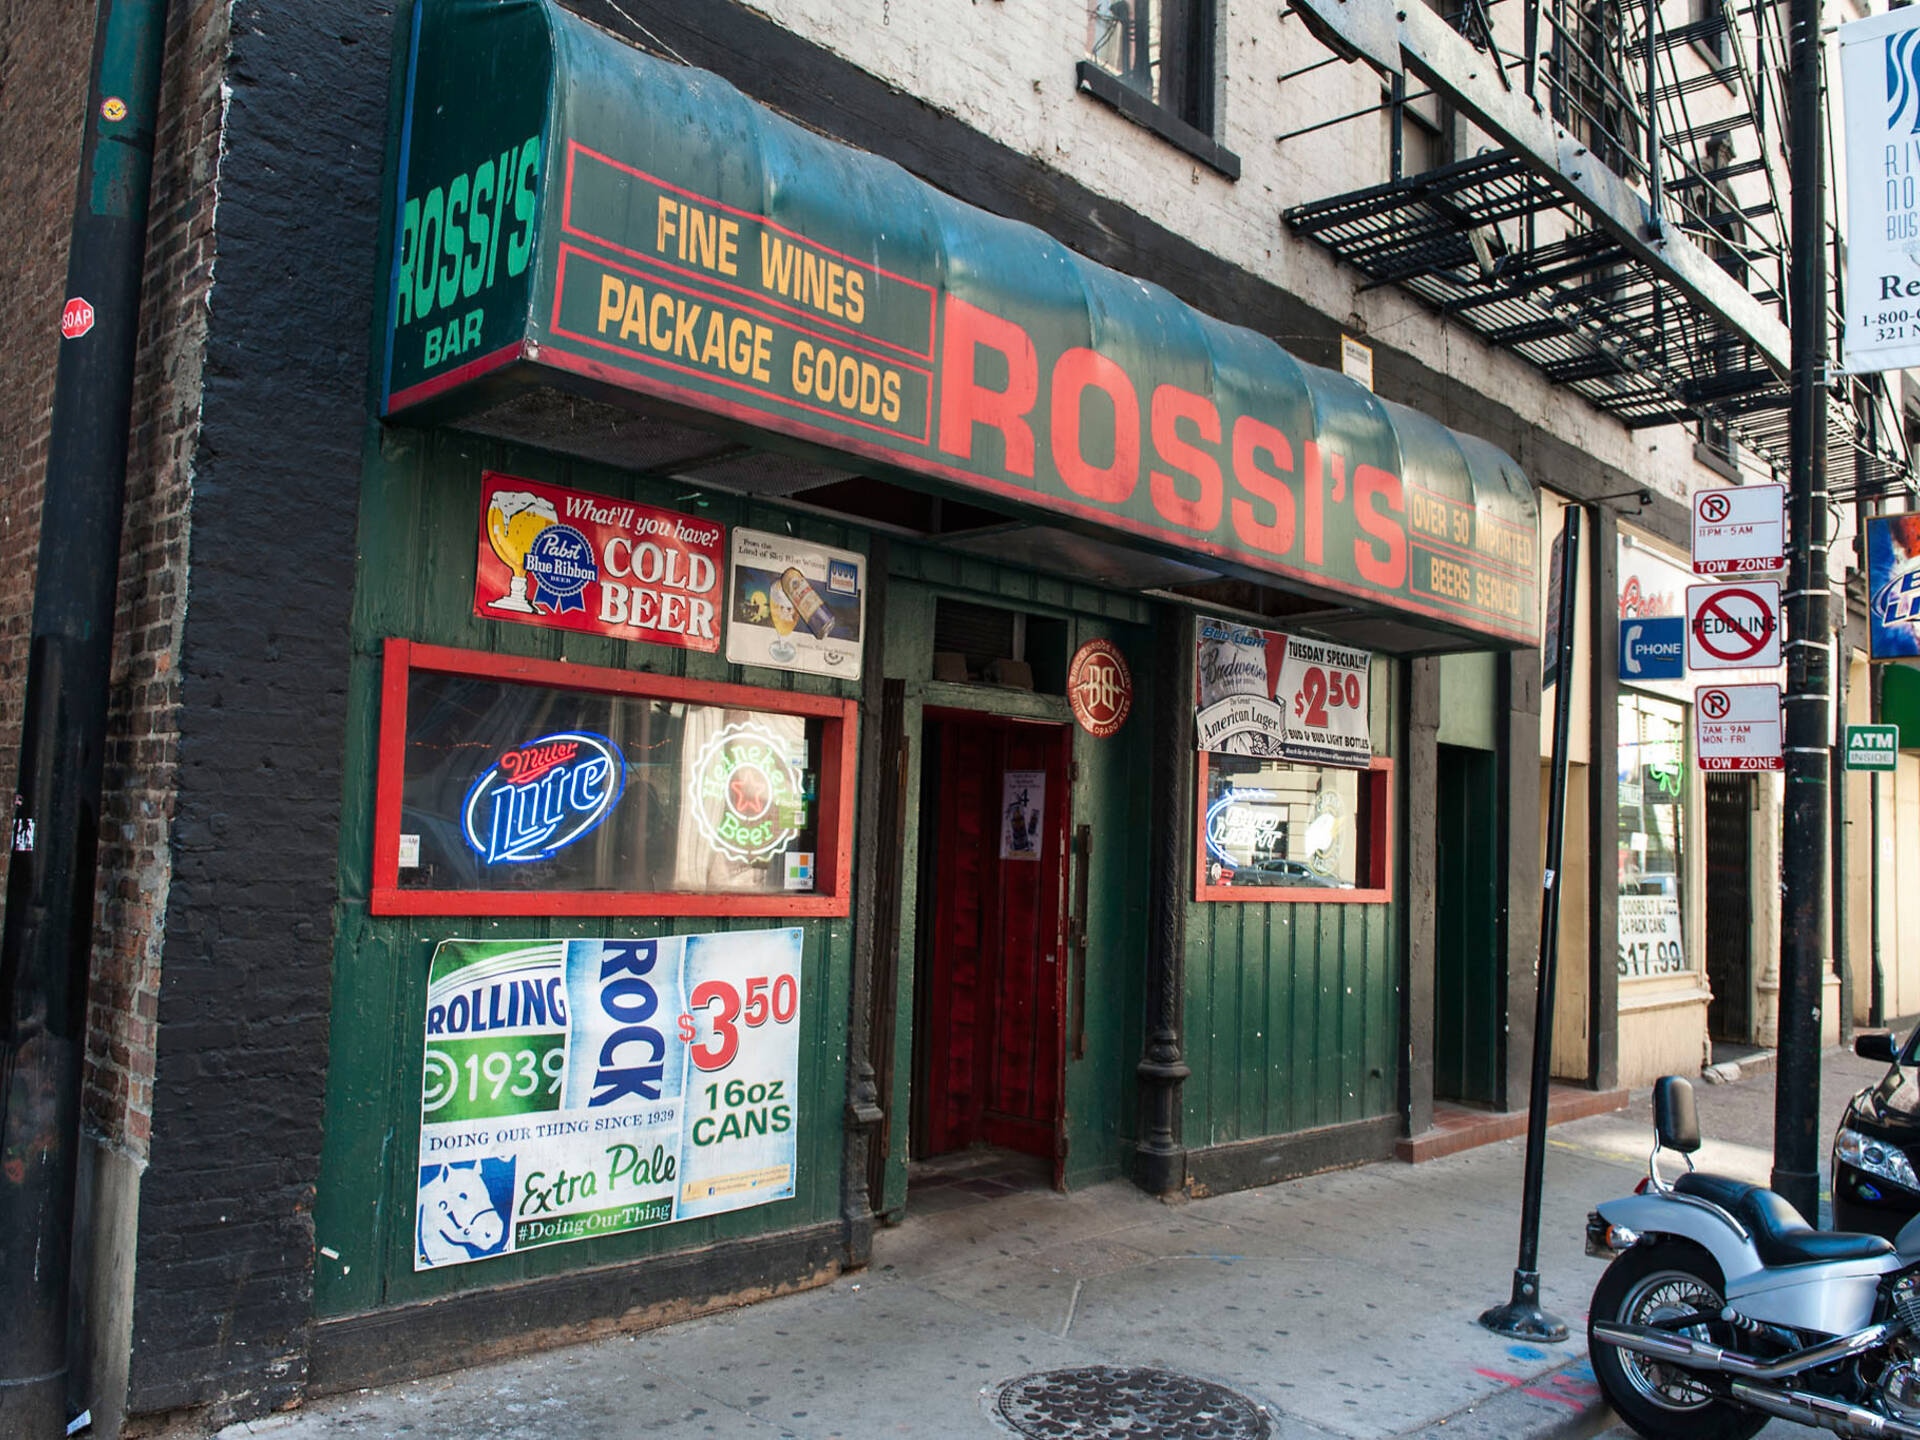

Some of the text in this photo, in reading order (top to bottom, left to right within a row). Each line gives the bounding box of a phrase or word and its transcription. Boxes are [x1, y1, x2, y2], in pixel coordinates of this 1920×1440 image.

[395, 134, 541, 330] ROSSI'S
[656, 195, 866, 324] FINE WINES
[62, 309, 92, 330] SOAP
[423, 307, 485, 369] BAR
[1875, 326, 1905, 342] 321
[597, 274, 901, 423] PACKAGE GOODS
[939, 292, 1406, 590] ROSSI'S
[565, 496, 719, 548] What'll you have?
[1413, 493, 1533, 567] OVER 50 IMPORTED
[543, 533, 582, 560] Pabst
[603, 537, 717, 594] COLD
[1699, 558, 1777, 573] TOW ZONE
[526, 555, 596, 581] Blue Ribbon
[1430, 556, 1521, 616] BEERS SERVED
[598, 581, 715, 640] BEER
[1691, 616, 1778, 635] PEDDLING
[1289, 641, 1325, 663] TUESDAY
[1635, 643, 1682, 655] PHONE
[1204, 708, 1250, 743] American
[1288, 729, 1304, 741] BUD
[1311, 732, 1326, 744] BUD
[1326, 734, 1343, 747] LIGHT
[1345, 736, 1369, 750] BOTTLES
[1702, 735, 1723, 744] MON
[1730, 735, 1746, 744] FRI
[1851, 733, 1894, 748] ATM
[501, 742, 579, 782] Miller
[1703, 758, 1777, 769] TOW ZONE
[1851, 752, 1892, 762] INSIDE
[487, 756, 609, 865] Lite
[717, 811, 774, 846] Beer
[427, 976, 567, 1035] ROLLING
[588, 939, 666, 1108] ROCK
[704, 1079, 785, 1111] 16oz
[430, 1109, 675, 1152] DOING OUR THING SINCE 1939
[692, 1103, 792, 1147] CANS
[519, 1143, 677, 1216] Extra Pale
[518, 1202, 672, 1242] #DoingOurThing
